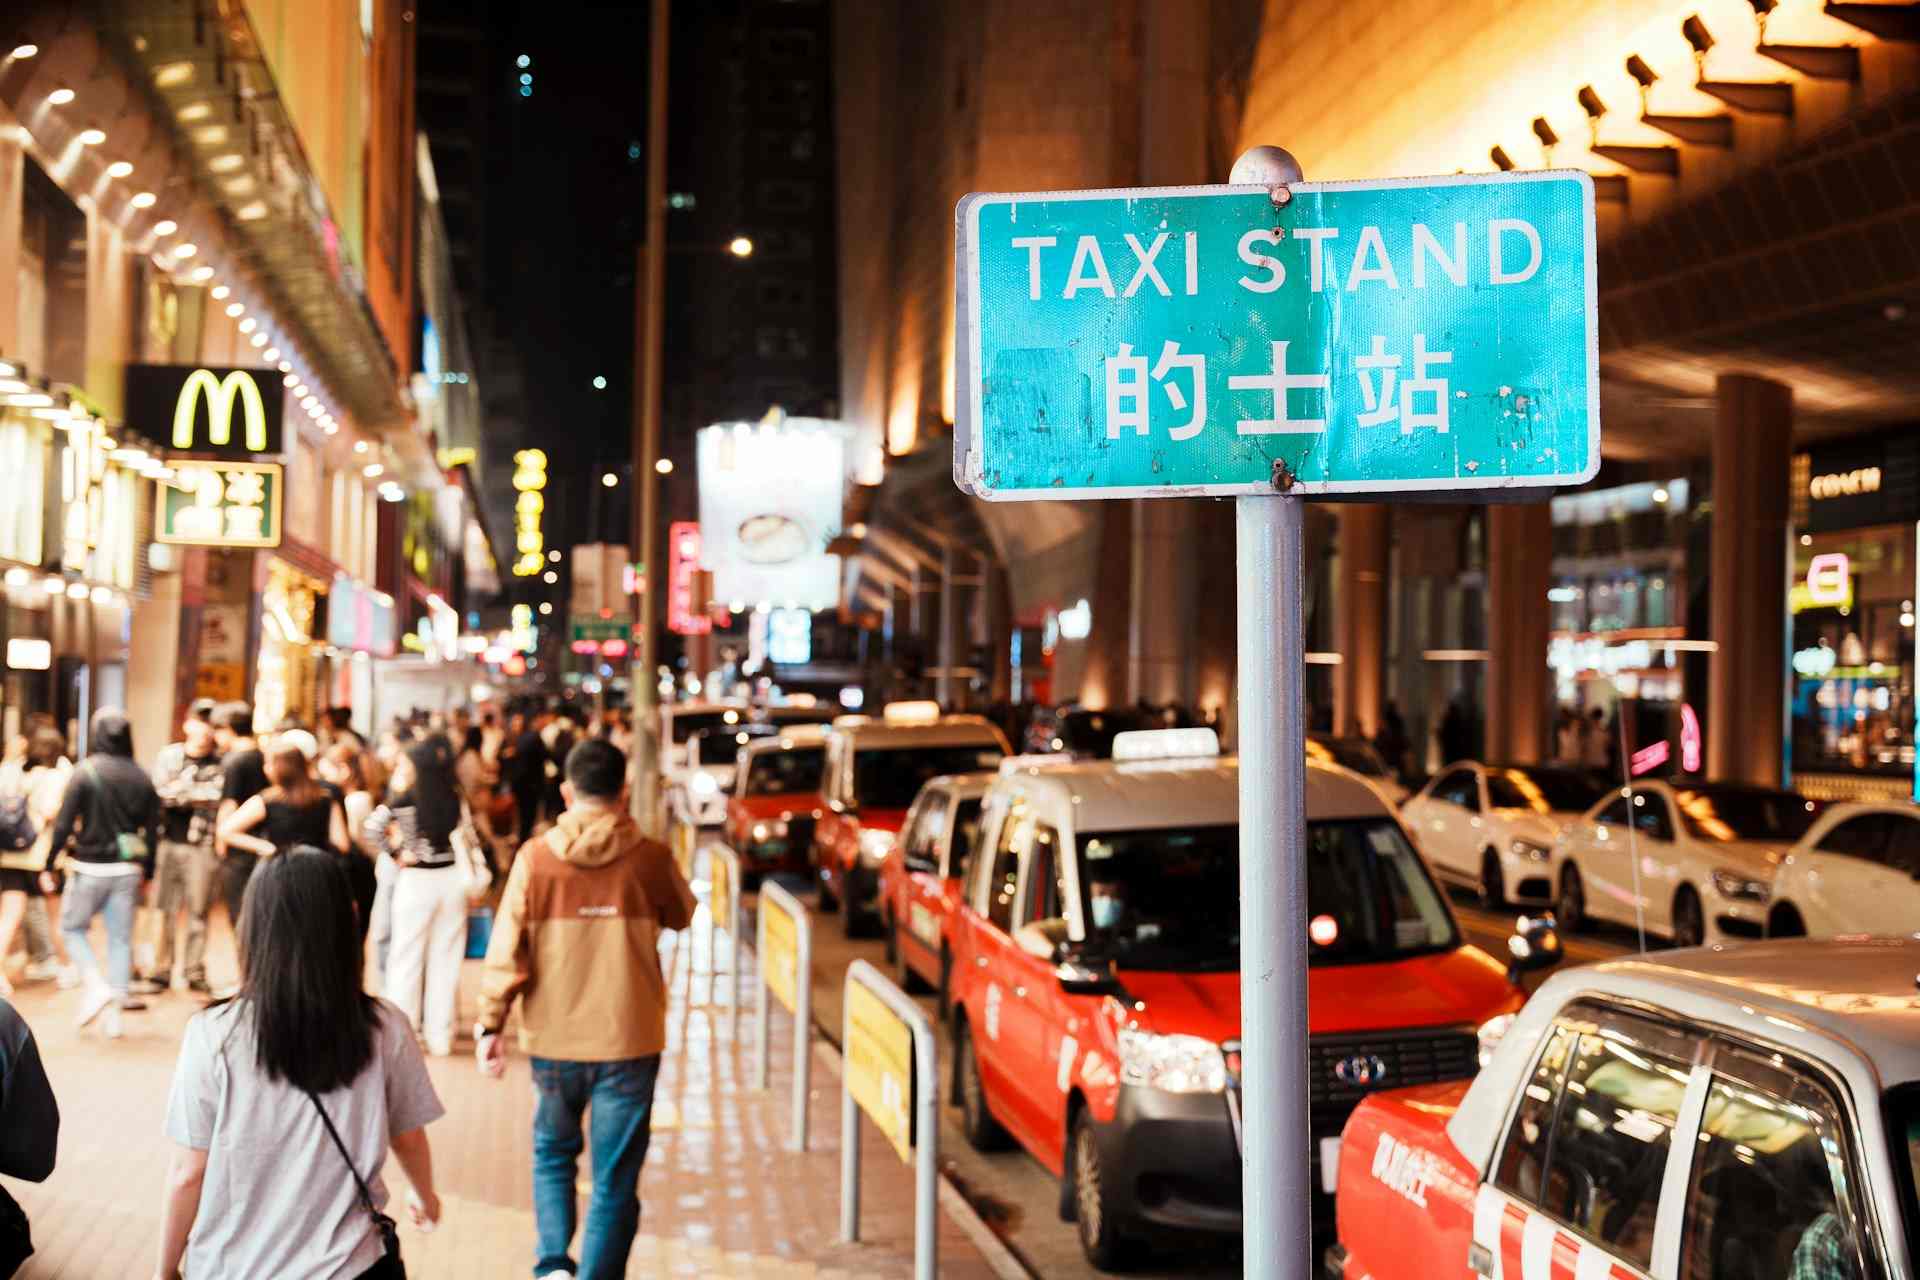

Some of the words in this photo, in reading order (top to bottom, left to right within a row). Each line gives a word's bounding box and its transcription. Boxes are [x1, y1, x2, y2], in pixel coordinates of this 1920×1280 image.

[1012, 231, 1199, 300] TAXI
[1237, 218, 1543, 294] STAND
[172, 368, 267, 452] M
[1105, 333, 1454, 442] 的士站
